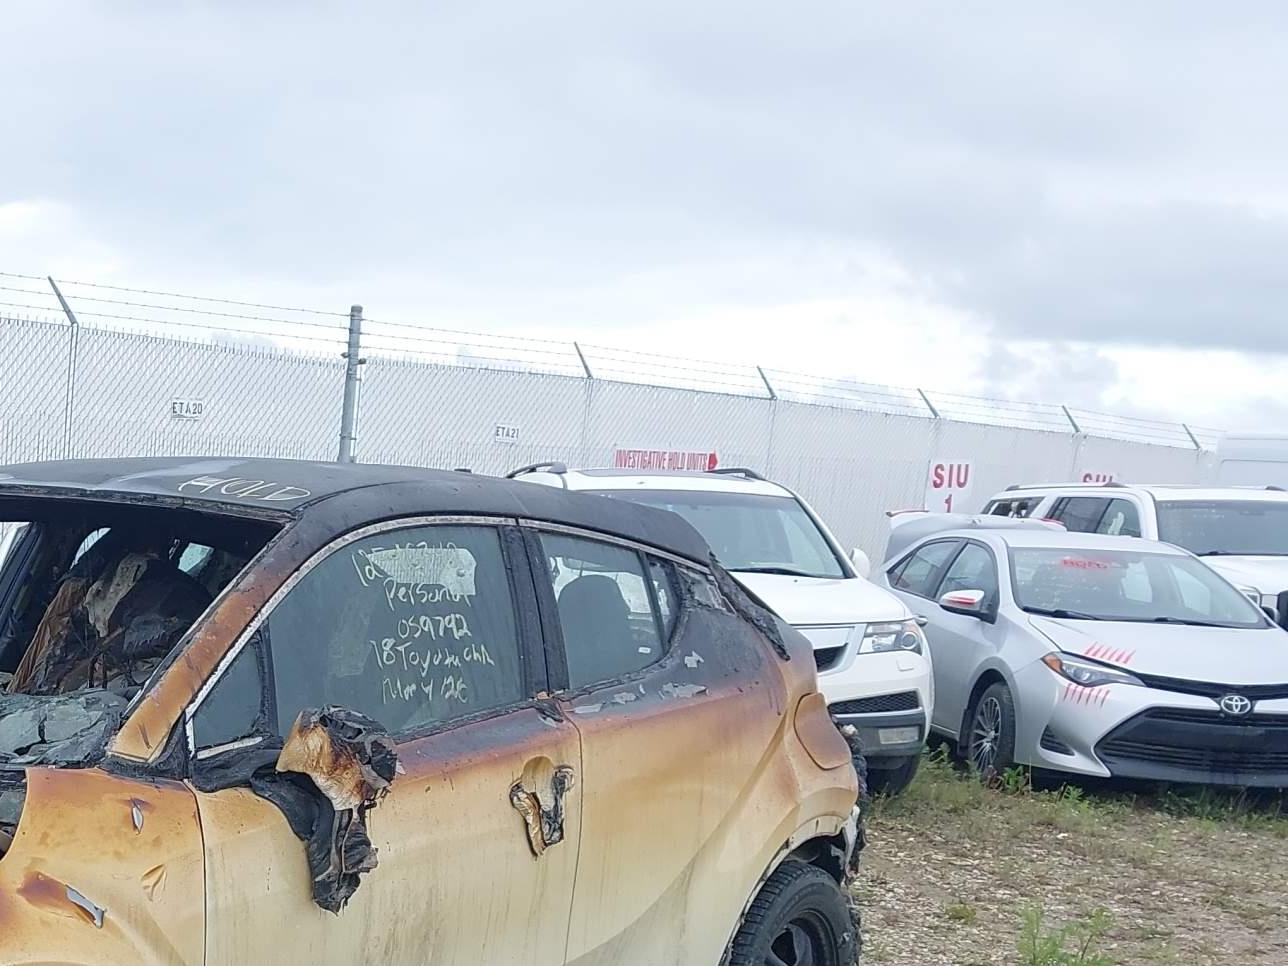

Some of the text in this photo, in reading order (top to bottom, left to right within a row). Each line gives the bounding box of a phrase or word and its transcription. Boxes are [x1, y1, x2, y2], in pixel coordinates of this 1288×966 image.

[173, 402, 202, 414] ETA20
[496, 426, 519, 438] ETA21
[615, 449, 707, 471] INVESTIGATIVE HOLD UNITS
[933, 464, 969, 488] SIU
[178, 475, 311, 501] HOLD
[944, 494, 952, 513] 1
